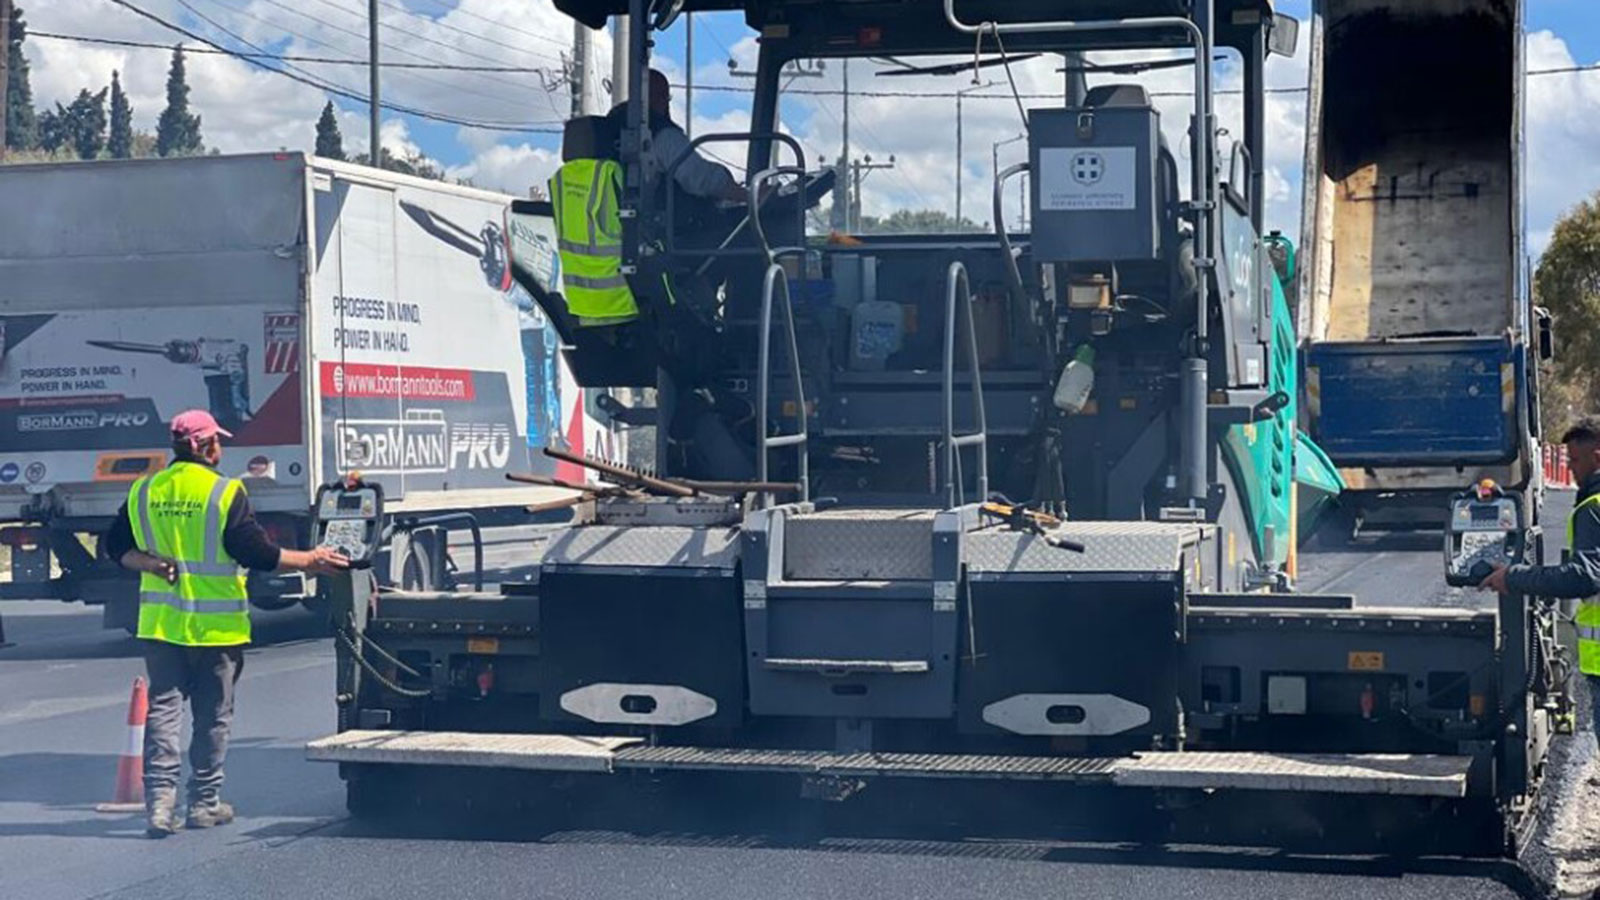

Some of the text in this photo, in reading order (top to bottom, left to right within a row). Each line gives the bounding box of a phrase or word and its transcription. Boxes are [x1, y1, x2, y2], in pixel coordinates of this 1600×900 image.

[332, 296, 385, 321] PROGRESS
[386, 301, 397, 322] IN
[333, 327, 370, 350] POWER
[372, 331, 382, 351] IN
[20, 366, 77, 379] PROGRESS
[80, 366, 90, 376] IN
[346, 369, 464, 398] www.bormanntools.com
[21, 381, 59, 393] POWER
[62, 380, 72, 391] IN
[99, 411, 149, 427] PRO
[449, 422, 510, 469] PRO
